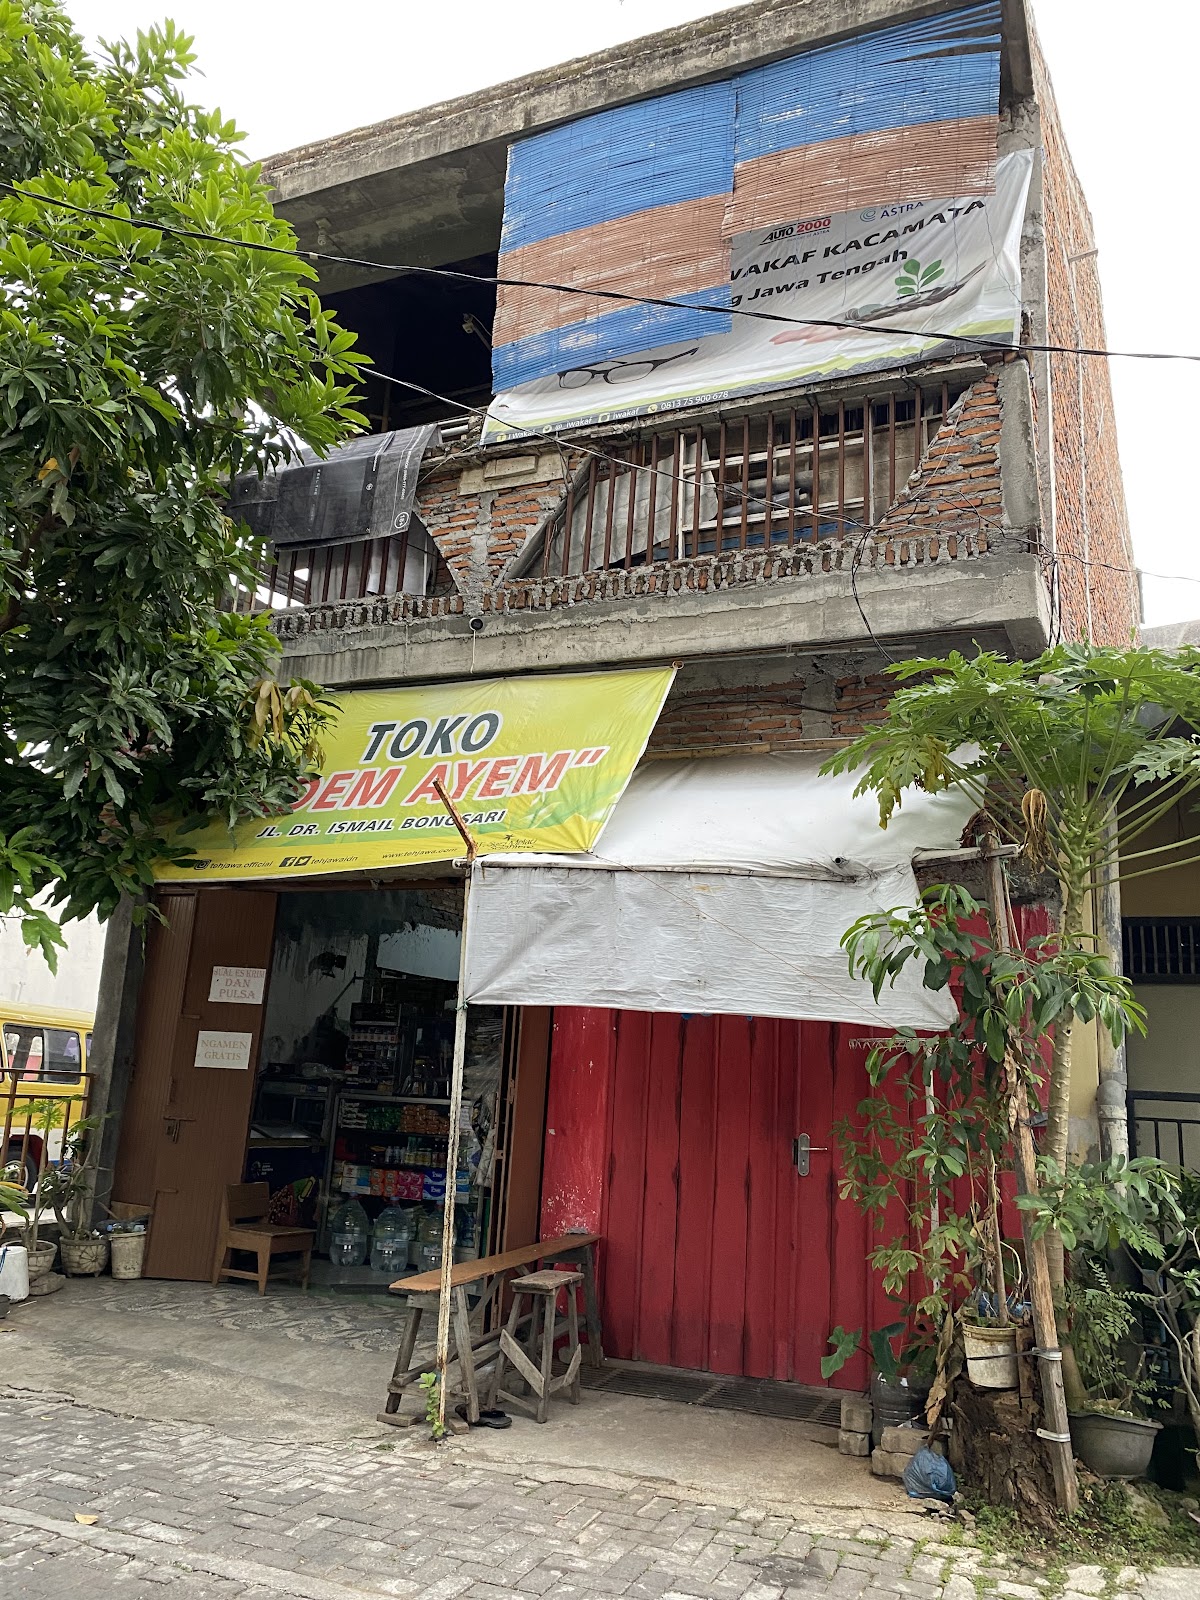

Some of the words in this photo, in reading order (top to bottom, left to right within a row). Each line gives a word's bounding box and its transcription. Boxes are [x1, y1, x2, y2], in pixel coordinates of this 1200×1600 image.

[880, 201, 924, 219] ASTRA
[761, 227, 793, 243] AUTO
[796, 218, 831, 234] 2000
[823, 200, 985, 259] KACAMATA
[747, 279, 809, 301] Jawa
[816, 249, 908, 284] Tengah
[612, 407, 640, 419] iwakaf
[660, 400, 681, 410] 0813
[683, 397, 693, 406] 75
[695, 394, 711, 403] 900
[712, 390, 729, 400] 678
[363, 712, 499, 761] TOKO
[240, 768, 402, 815] DEM
[256, 826, 280, 838] JL.
[288, 824, 319, 836] DR.
[327, 819, 394, 834] ISMAIL
[209, 860, 274, 870] tehjawa.official
[213, 967, 233, 977] JUAL
[235, 969, 245, 977] ES
[225, 978, 251, 988] DAN
[219, 989, 256, 999] PULSA
[200, 1039, 248, 1050] NGAMEN
[204, 1051, 241, 1061] GRATIS
